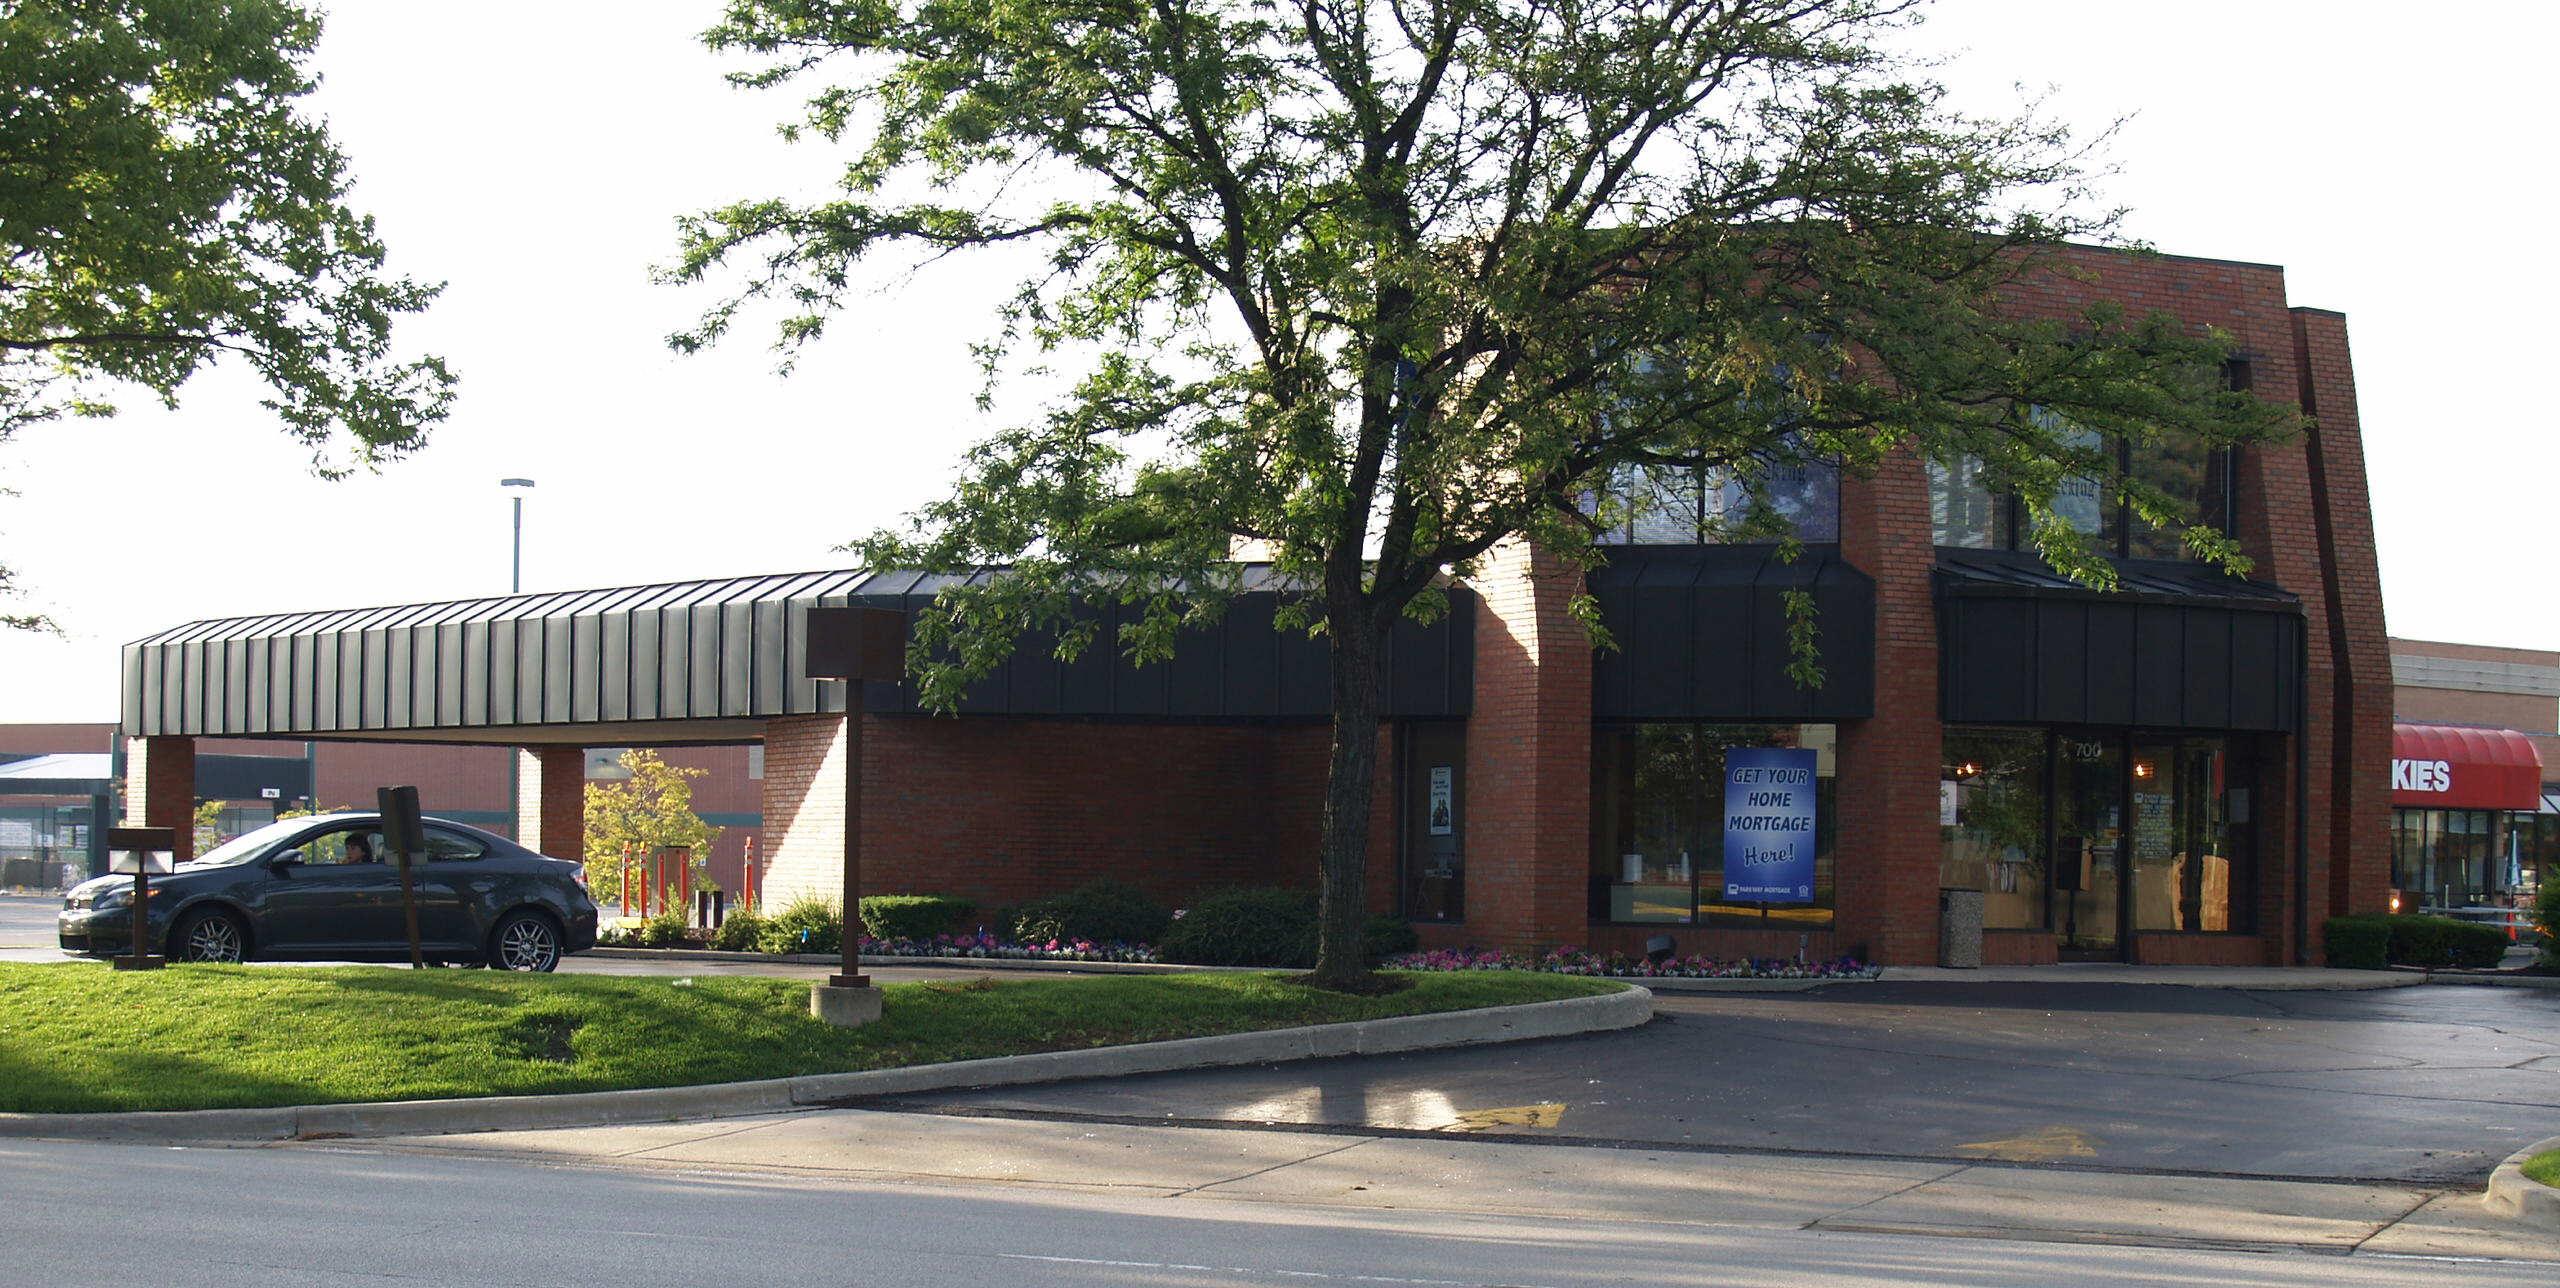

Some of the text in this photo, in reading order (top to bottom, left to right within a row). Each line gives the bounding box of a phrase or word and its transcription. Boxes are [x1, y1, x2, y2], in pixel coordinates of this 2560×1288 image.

[2075, 742, 2102, 757] 700
[1733, 767, 1808, 785] GET YOUR
[2391, 758, 2450, 792] KIES
[1747, 791, 1793, 808] HOME
[1728, 815, 1811, 832] MORTGAGE
[1744, 843, 1795, 867] Here!
